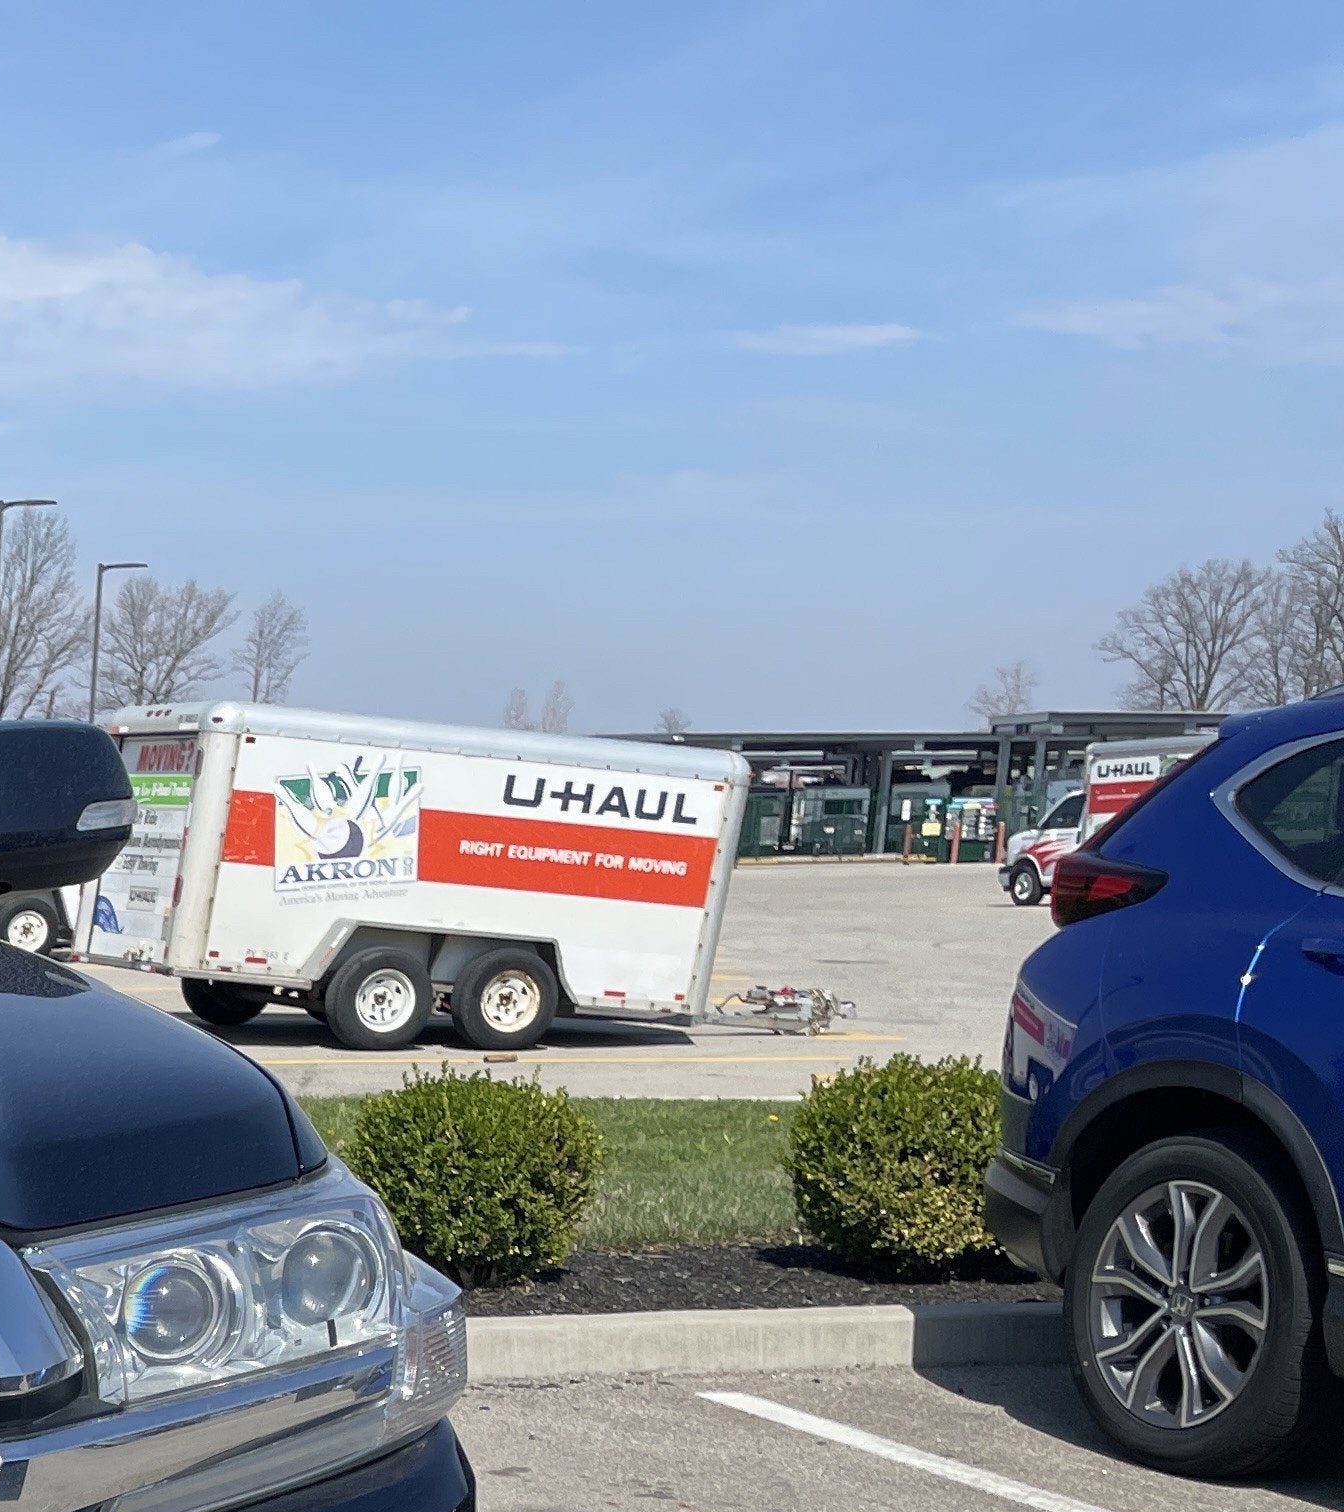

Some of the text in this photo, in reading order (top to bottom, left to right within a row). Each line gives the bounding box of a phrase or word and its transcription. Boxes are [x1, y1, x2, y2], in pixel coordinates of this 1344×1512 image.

[1097, 762, 1154, 778] U-HAUL
[503, 774, 698, 825] U-HAUL
[278, 857, 398, 884] AKRON
[459, 839, 688, 877] RIGHT EQUIPMENT FOR MOVING
[279, 892, 321, 906] America's
